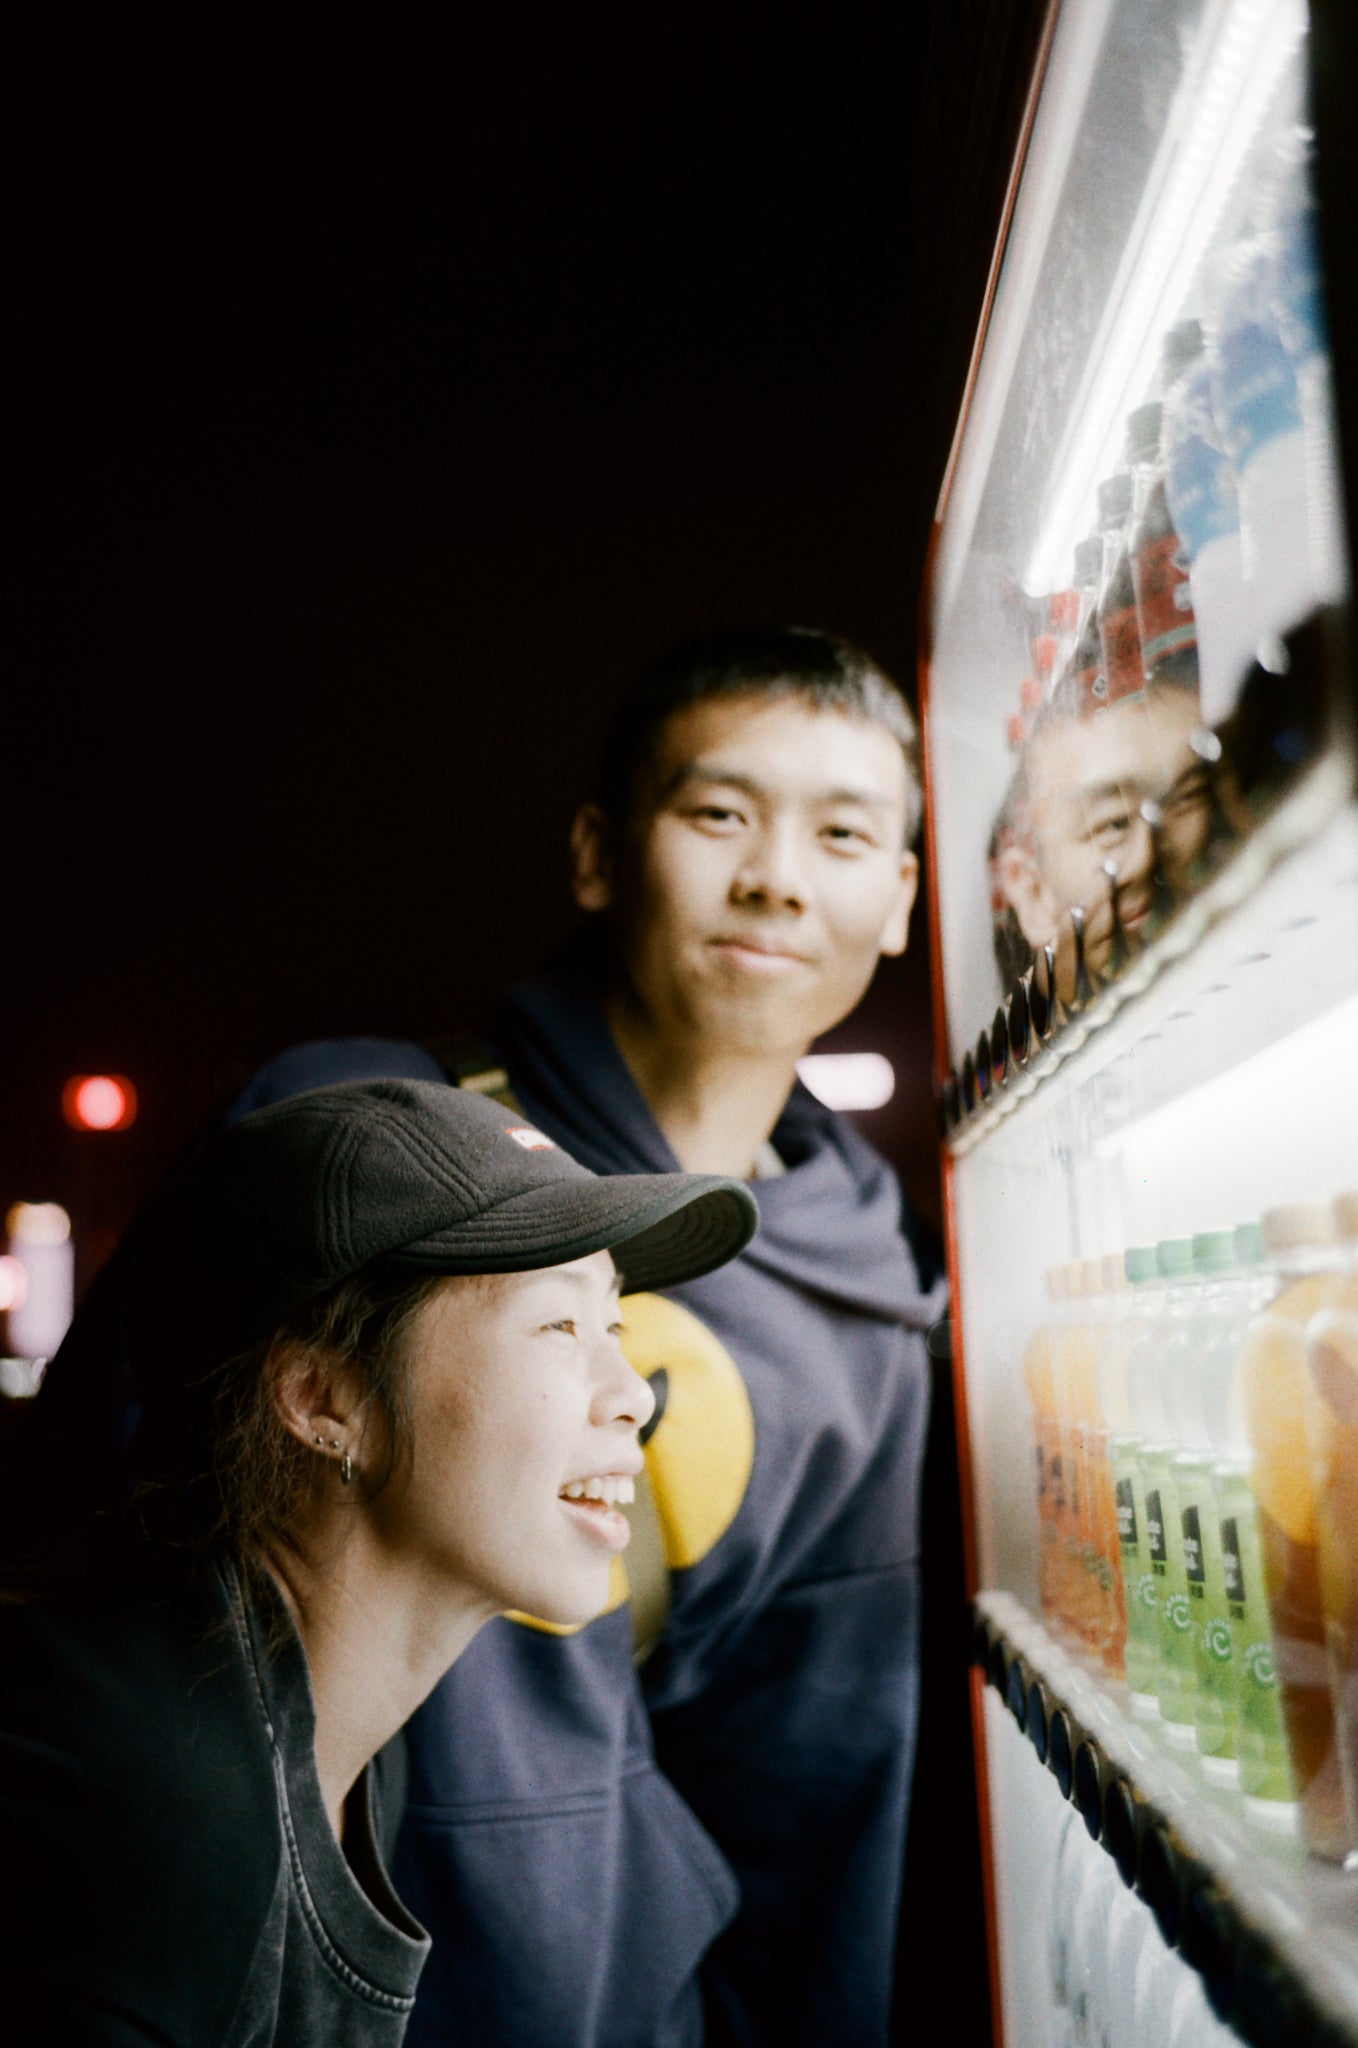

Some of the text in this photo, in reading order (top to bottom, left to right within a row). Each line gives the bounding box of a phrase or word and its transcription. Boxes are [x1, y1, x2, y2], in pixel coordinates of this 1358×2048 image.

[1173, 1606, 1189, 1628] C
[1213, 1632, 1229, 1655] C
[1254, 1657, 1275, 1682] C
